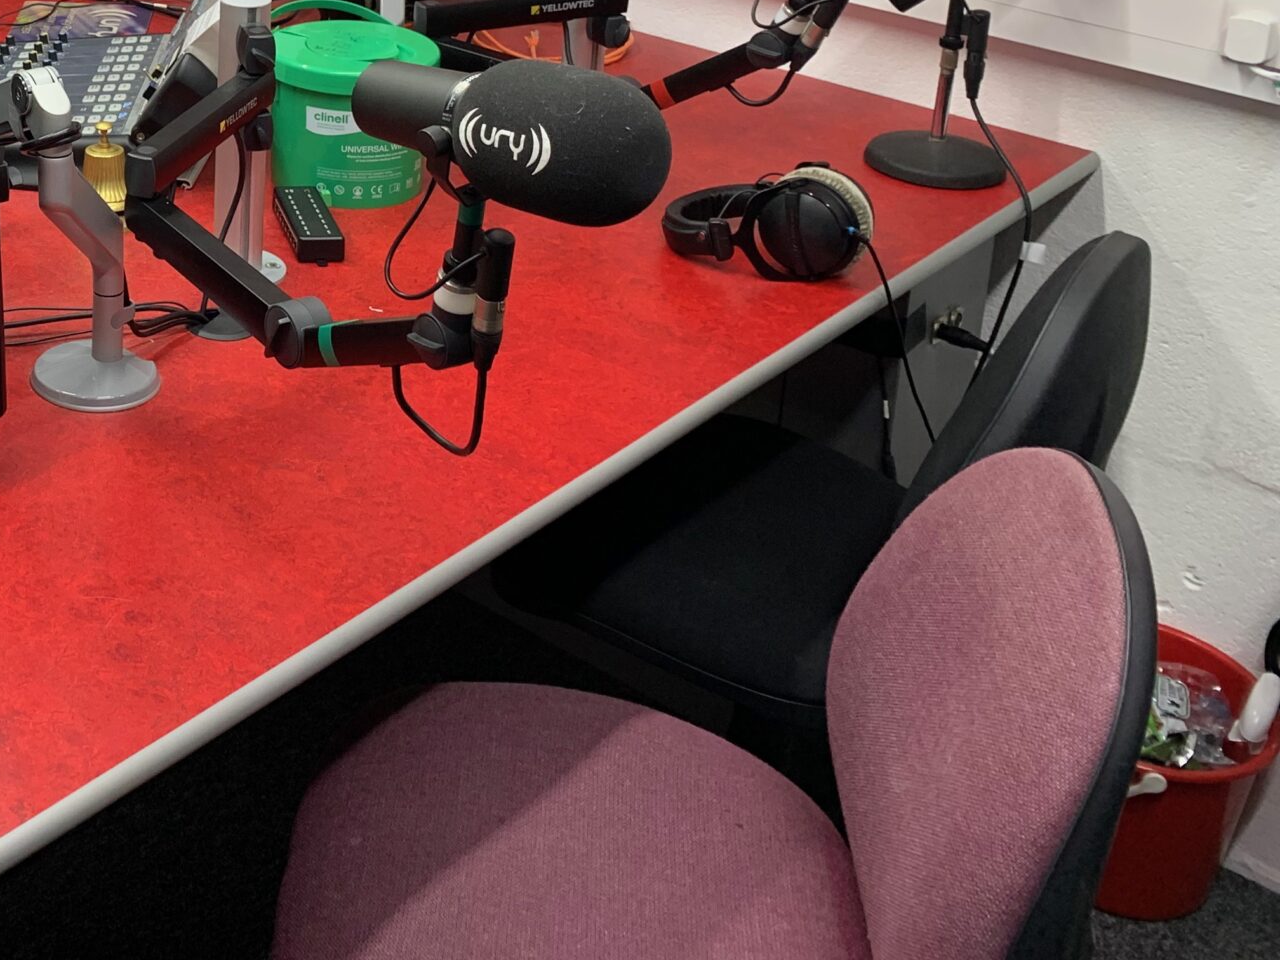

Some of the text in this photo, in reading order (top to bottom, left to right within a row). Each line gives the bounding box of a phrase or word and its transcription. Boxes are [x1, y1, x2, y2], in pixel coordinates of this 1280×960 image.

[541, 0, 595, 13] YELLOWTEC
[226, 96, 258, 128] YELLOWTEC
[314, 111, 349, 124] clinell
[480, 122, 526, 161] ury
[341, 144, 389, 154] UNIVERSAL
